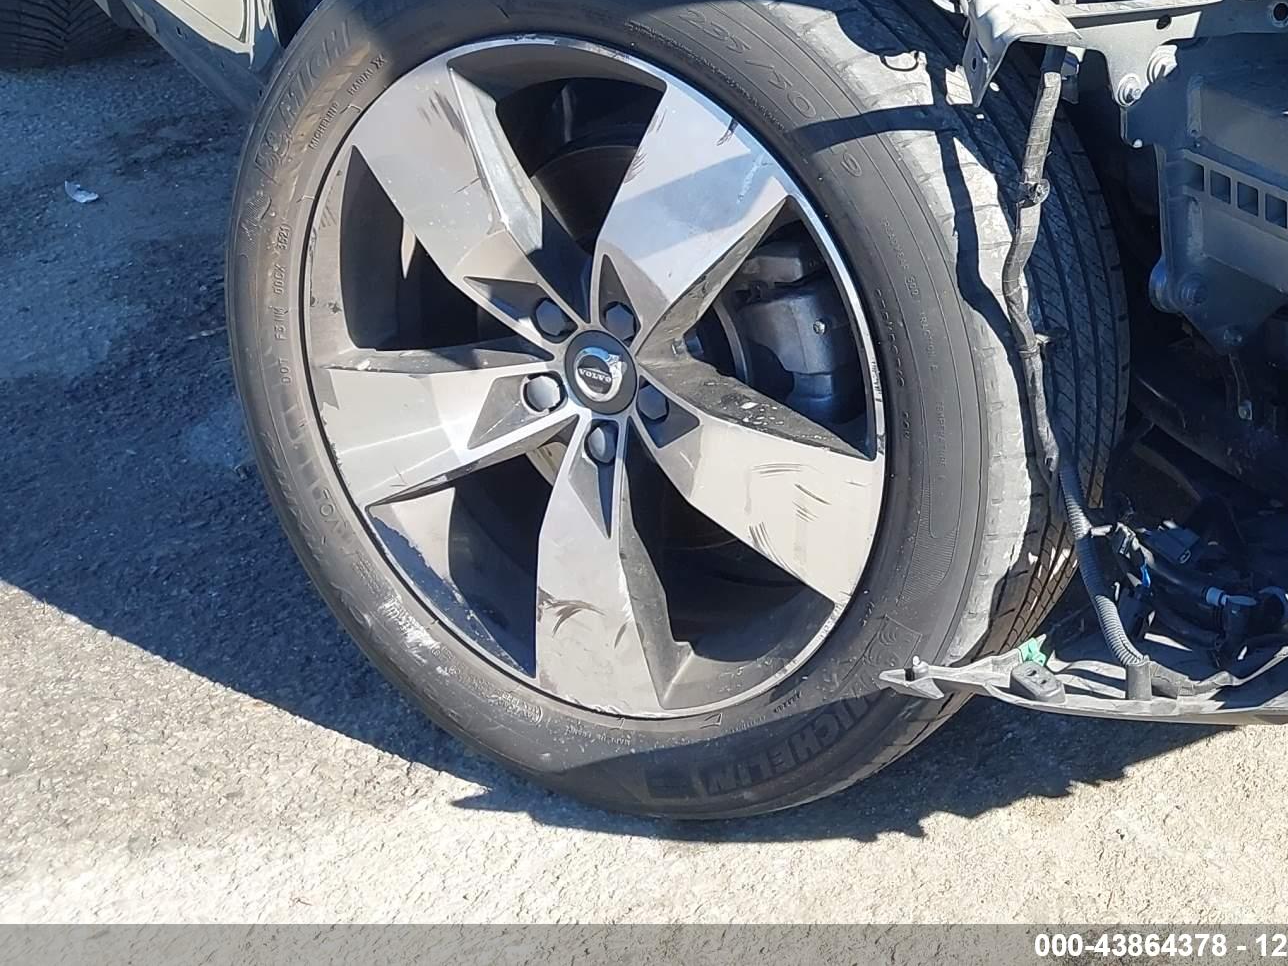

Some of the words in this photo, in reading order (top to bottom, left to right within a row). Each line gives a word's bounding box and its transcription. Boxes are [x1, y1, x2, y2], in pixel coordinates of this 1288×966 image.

[277, 357, 291, 384] DOT
[579, 368, 612, 383] VOLVO
[704, 680, 882, 796] MICHELIN
